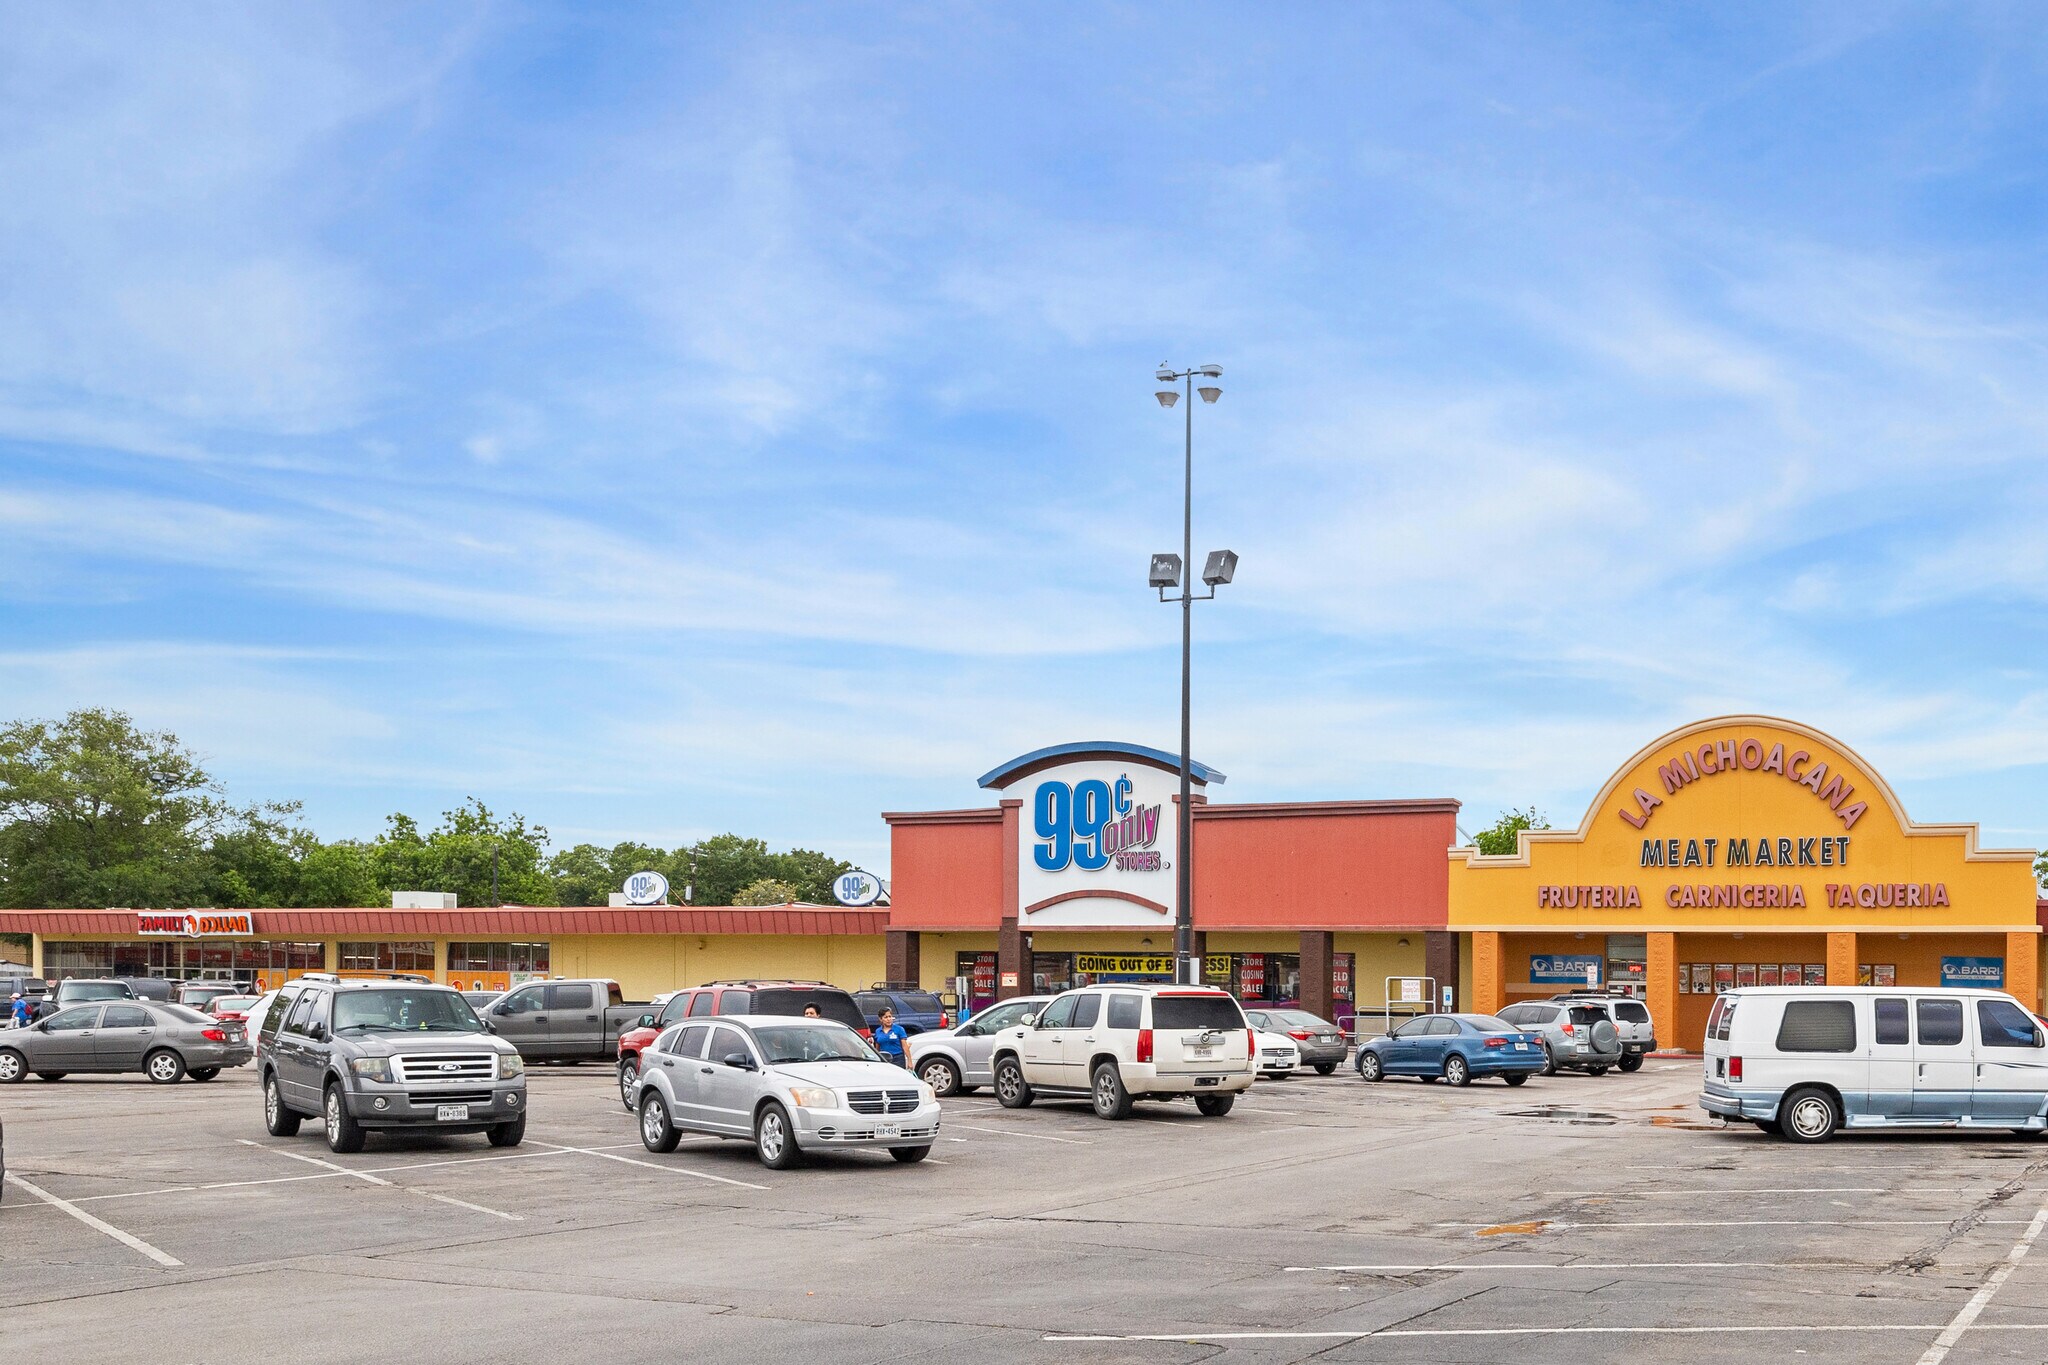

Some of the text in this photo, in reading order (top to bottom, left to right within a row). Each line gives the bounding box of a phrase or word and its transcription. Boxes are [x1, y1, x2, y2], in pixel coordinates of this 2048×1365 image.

[1618, 738, 1868, 830] LA MICHOACANA
[1103, 803, 1161, 856] only
[1640, 836, 1850, 867] MEAT MARKET
[1115, 851, 1161, 871] STORES
[1538, 883, 1950, 908] FRUTERIA CARNICERIA TAQUERIA
[138, 916, 249, 933] FAMILY DOLLAR
[1079, 957, 1116, 971] GOING
[1119, 958, 1143, 971] OUT
[1146, 959, 1162, 971] OF
[1241, 958, 1264, 966] STORE
[1241, 970, 1264, 980] CLOSING
[1961, 966, 2000, 975] BARRI
[974, 979, 995, 988] SALE!
[1241, 984, 1264, 993] SALE!
